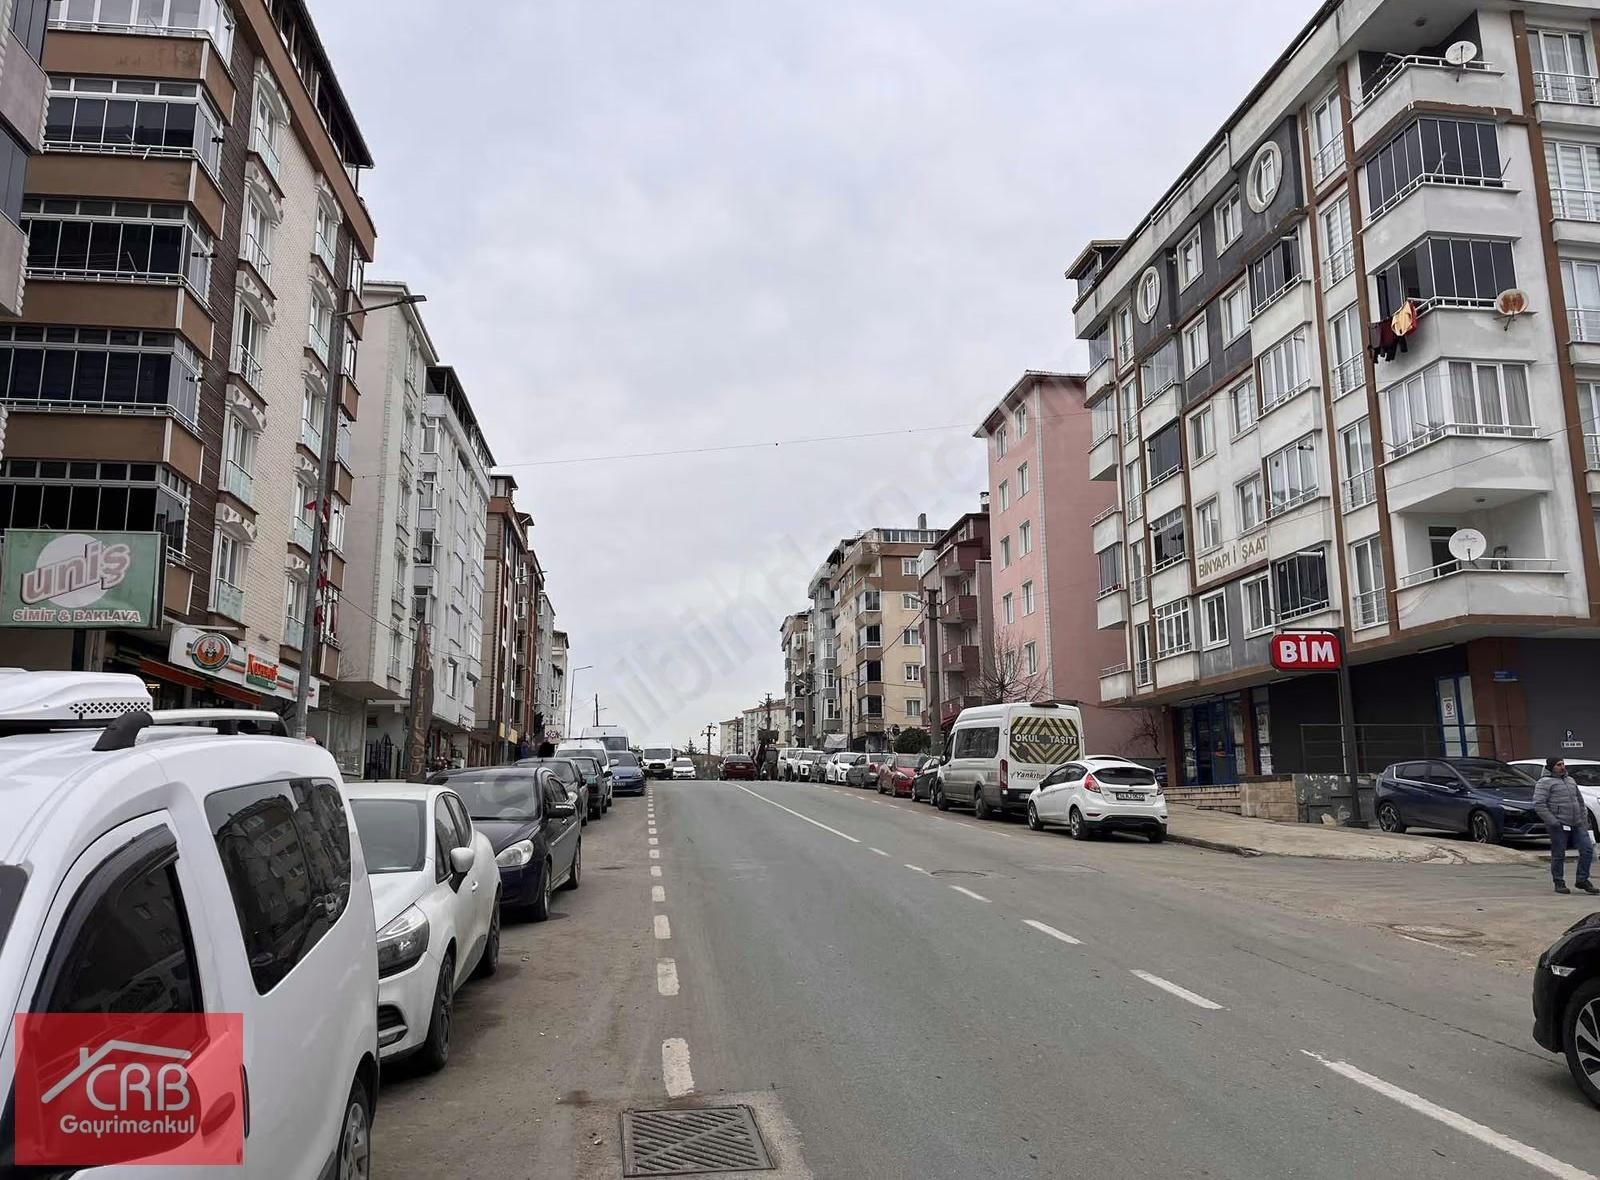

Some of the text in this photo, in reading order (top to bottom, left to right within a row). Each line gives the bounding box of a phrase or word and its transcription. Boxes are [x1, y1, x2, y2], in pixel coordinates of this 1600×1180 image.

[13, 607, 141, 622] SİMİT & BAKLAVA
[1279, 635, 1335, 663] BİM
[1015, 734, 1077, 745] OKUL TAŞITI
